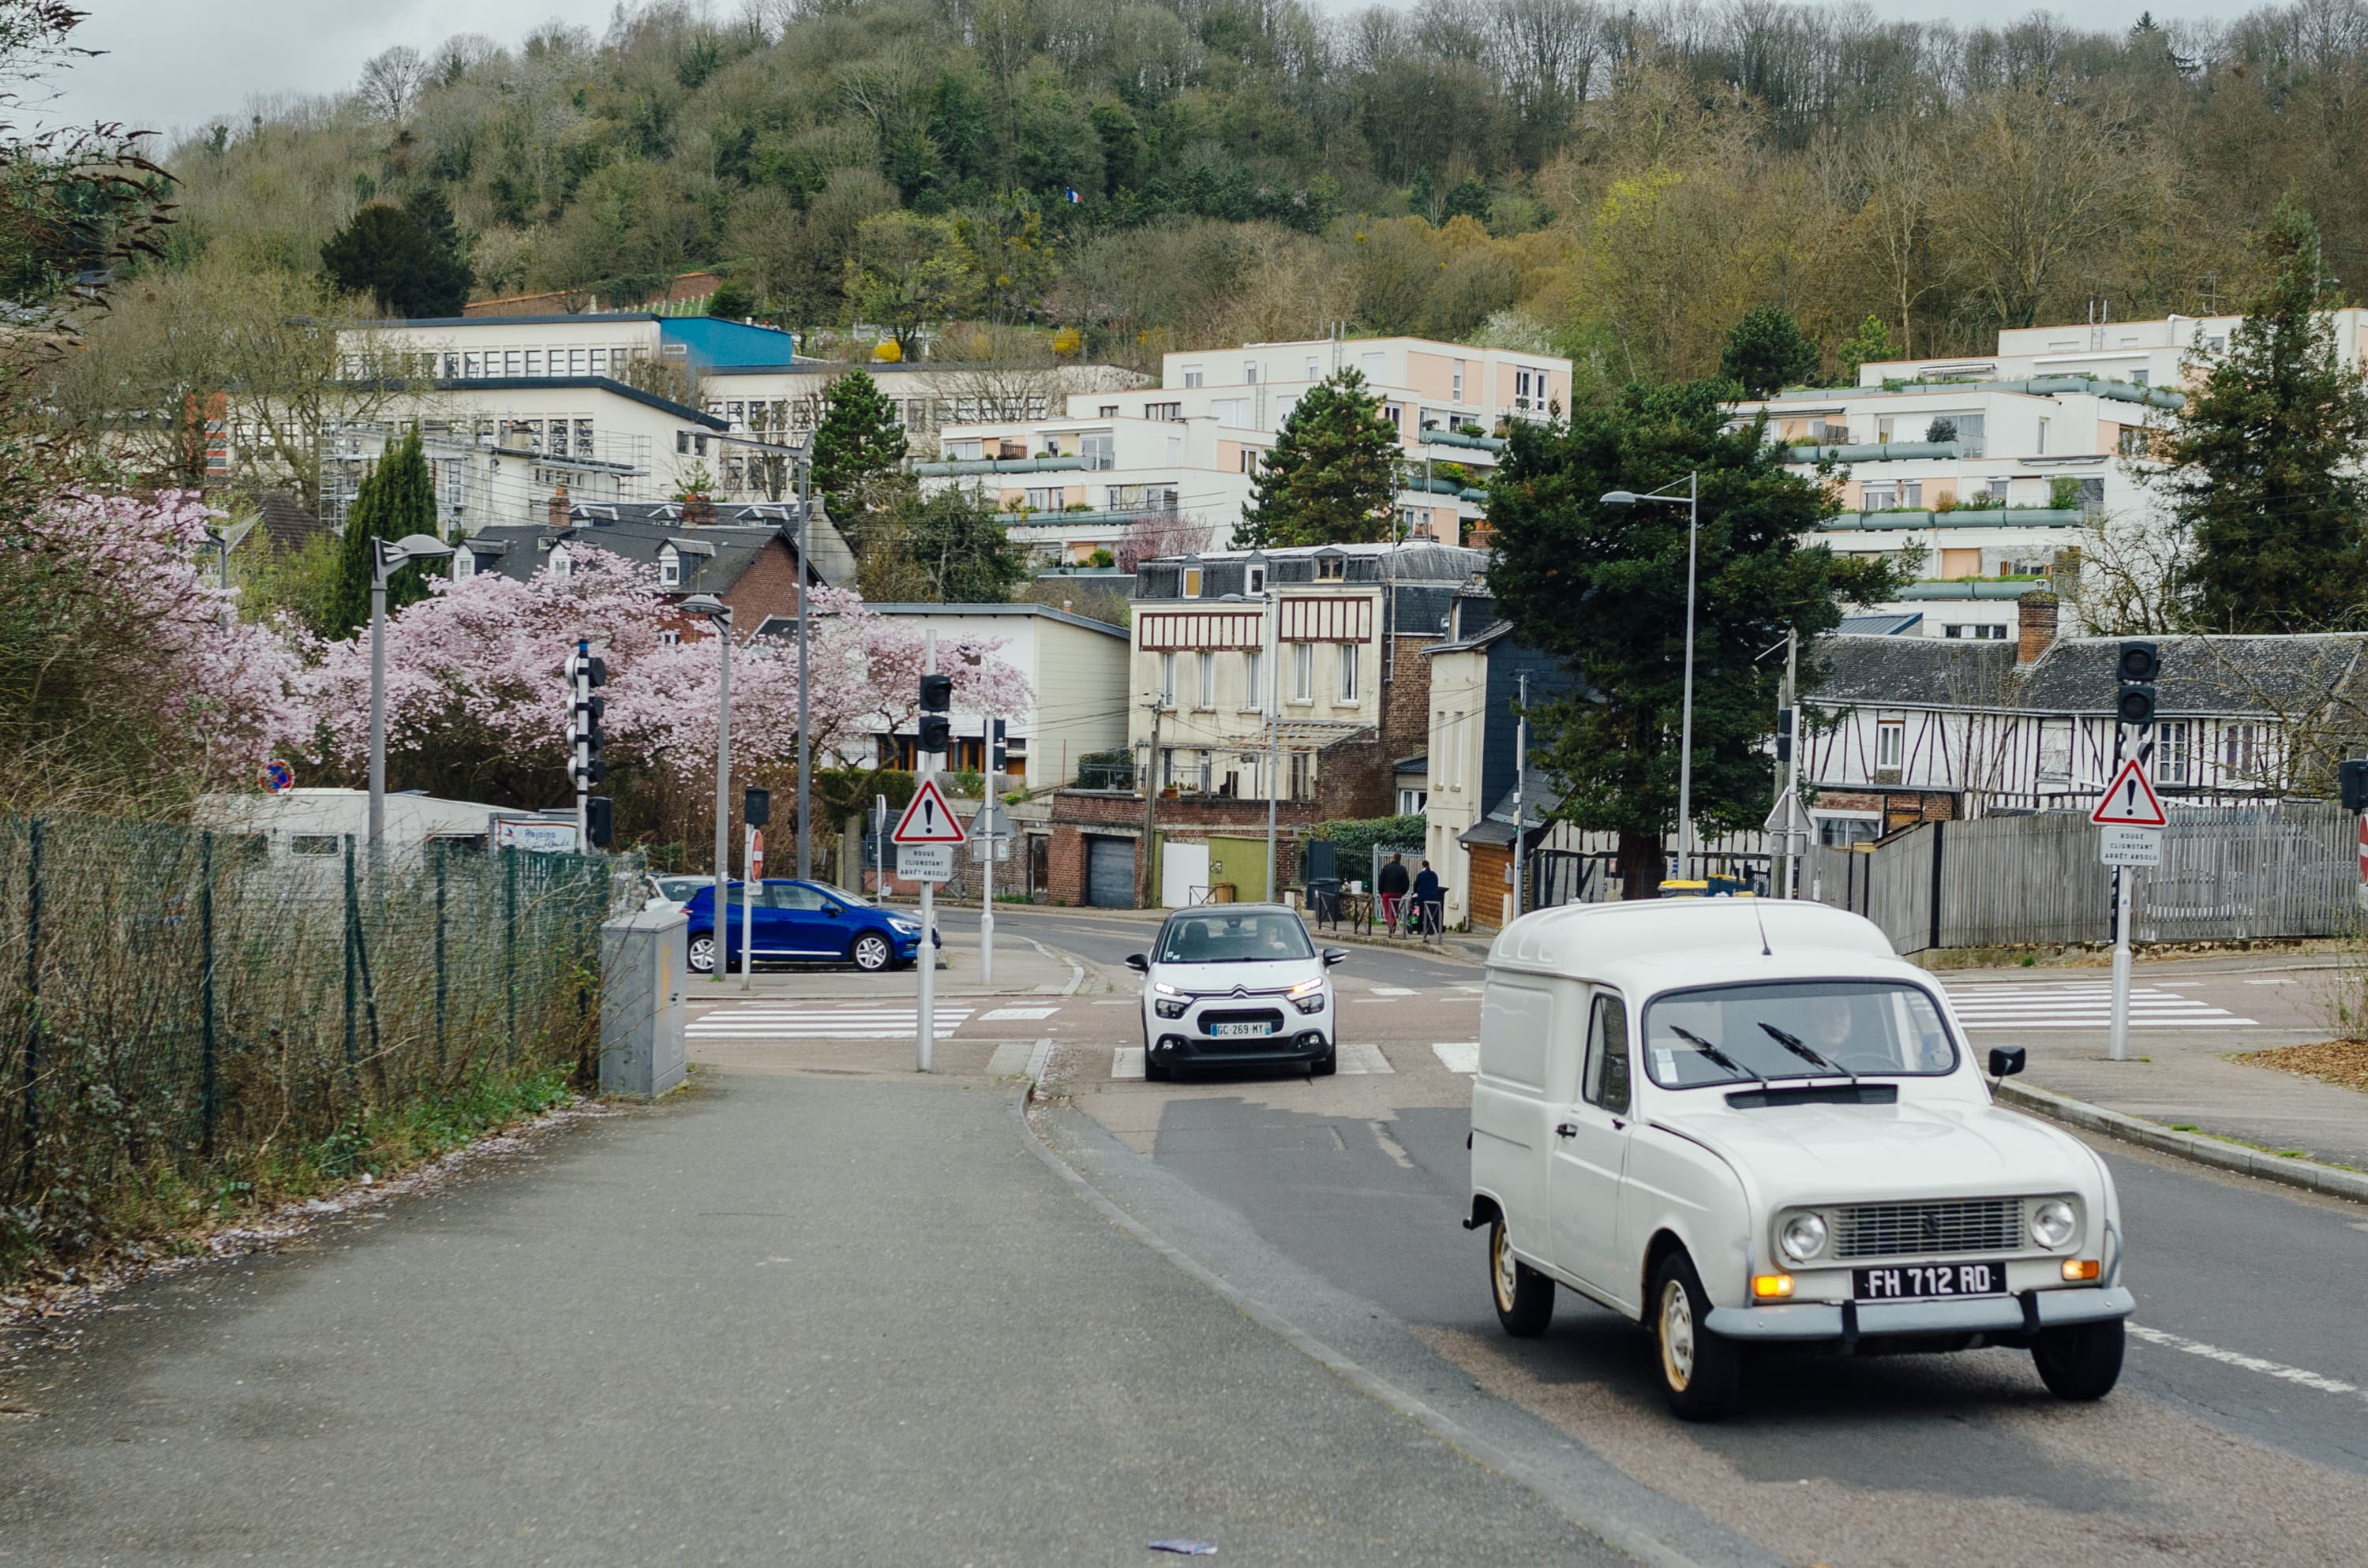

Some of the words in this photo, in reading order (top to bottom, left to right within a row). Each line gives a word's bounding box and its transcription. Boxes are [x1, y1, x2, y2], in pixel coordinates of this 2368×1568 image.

[1868, 1270, 1902, 1298] FH
[1906, 1267, 1954, 1296] 712
[1959, 1264, 1991, 1293] RD
